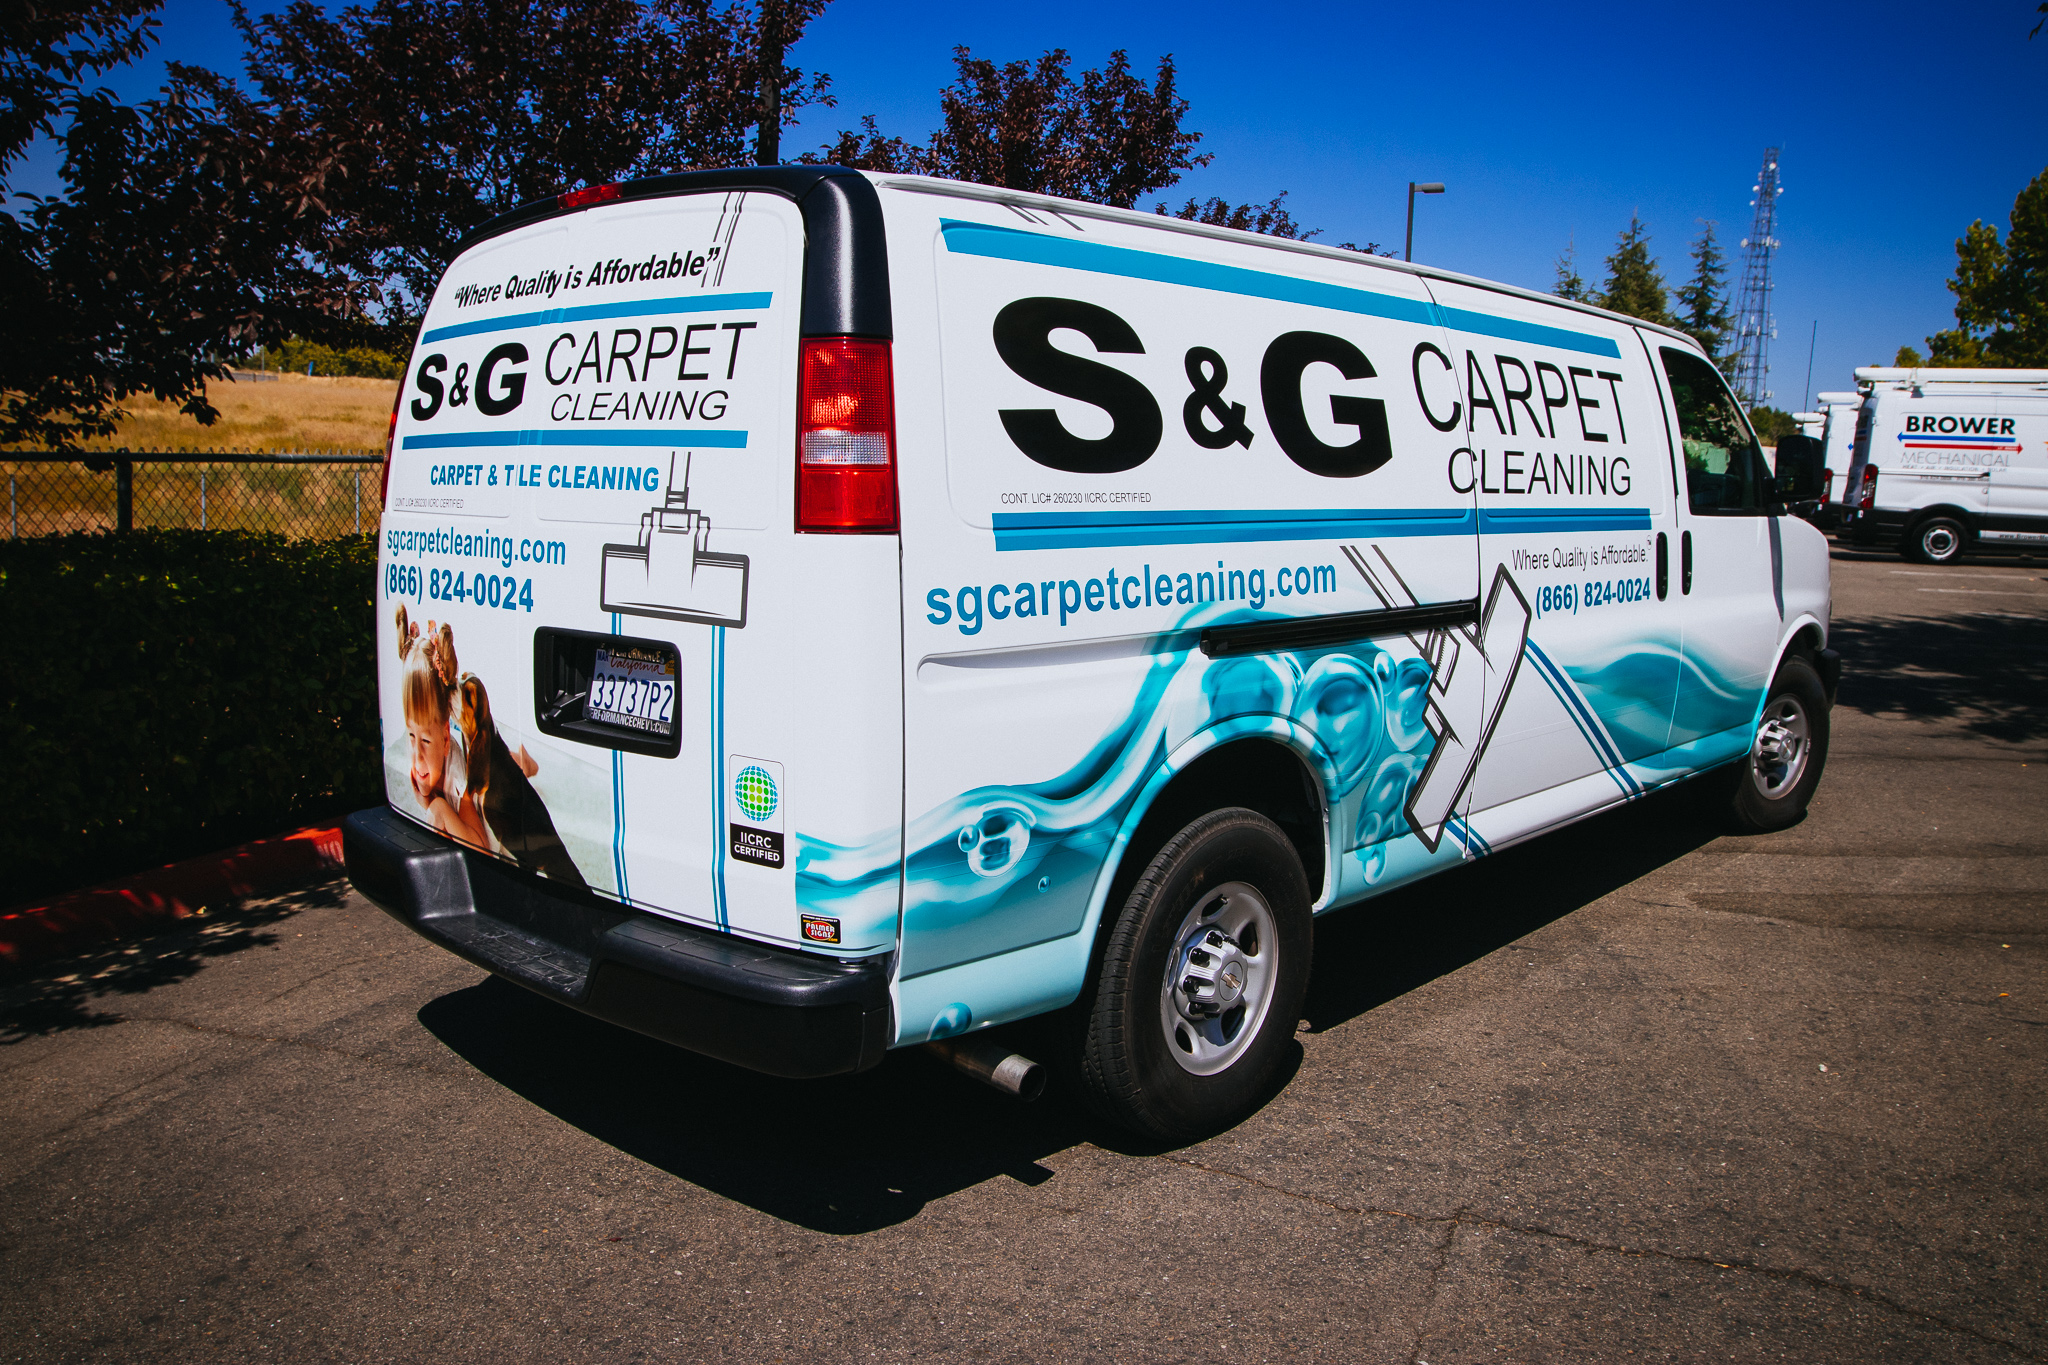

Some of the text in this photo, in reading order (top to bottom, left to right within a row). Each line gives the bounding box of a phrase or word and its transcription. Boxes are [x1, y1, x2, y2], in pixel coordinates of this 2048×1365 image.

[505, 269, 562, 298] Quality
[563, 265, 583, 290] is
[545, 321, 758, 386] CARPET
[551, 390, 729, 422] CLEANING
[1412, 341, 1626, 444] CARPET
[1906, 416, 2016, 435] BROWER
[1448, 447, 1631, 496] CLEANING
[1900, 451, 2010, 467] MECHANICAL
[430, 464, 659, 492] CARPET & TLE CLEANING
[1001, 492, 1152, 505] CONT. LIC# 260230 IICRC CERTIFIED
[387, 527, 566, 568] sgcarpetcleaning.com
[1512, 549, 1549, 570] Where
[1552, 547, 1588, 572] Quality
[1590, 546, 1600, 566] is
[385, 563, 534, 613] (866) 824-0024
[926, 560, 1337, 636] sgcarpetcleaning.com
[1536, 577, 1651, 620] (866) 824-0024
[610, 657, 666, 676] California
[593, 672, 673, 721] 33737P2
[734, 844, 780, 862] CERTIFIED
[740, 831, 772, 849] IICRC
[805, 922, 835, 933] PALMER
[811, 929, 831, 938] SIGNS
